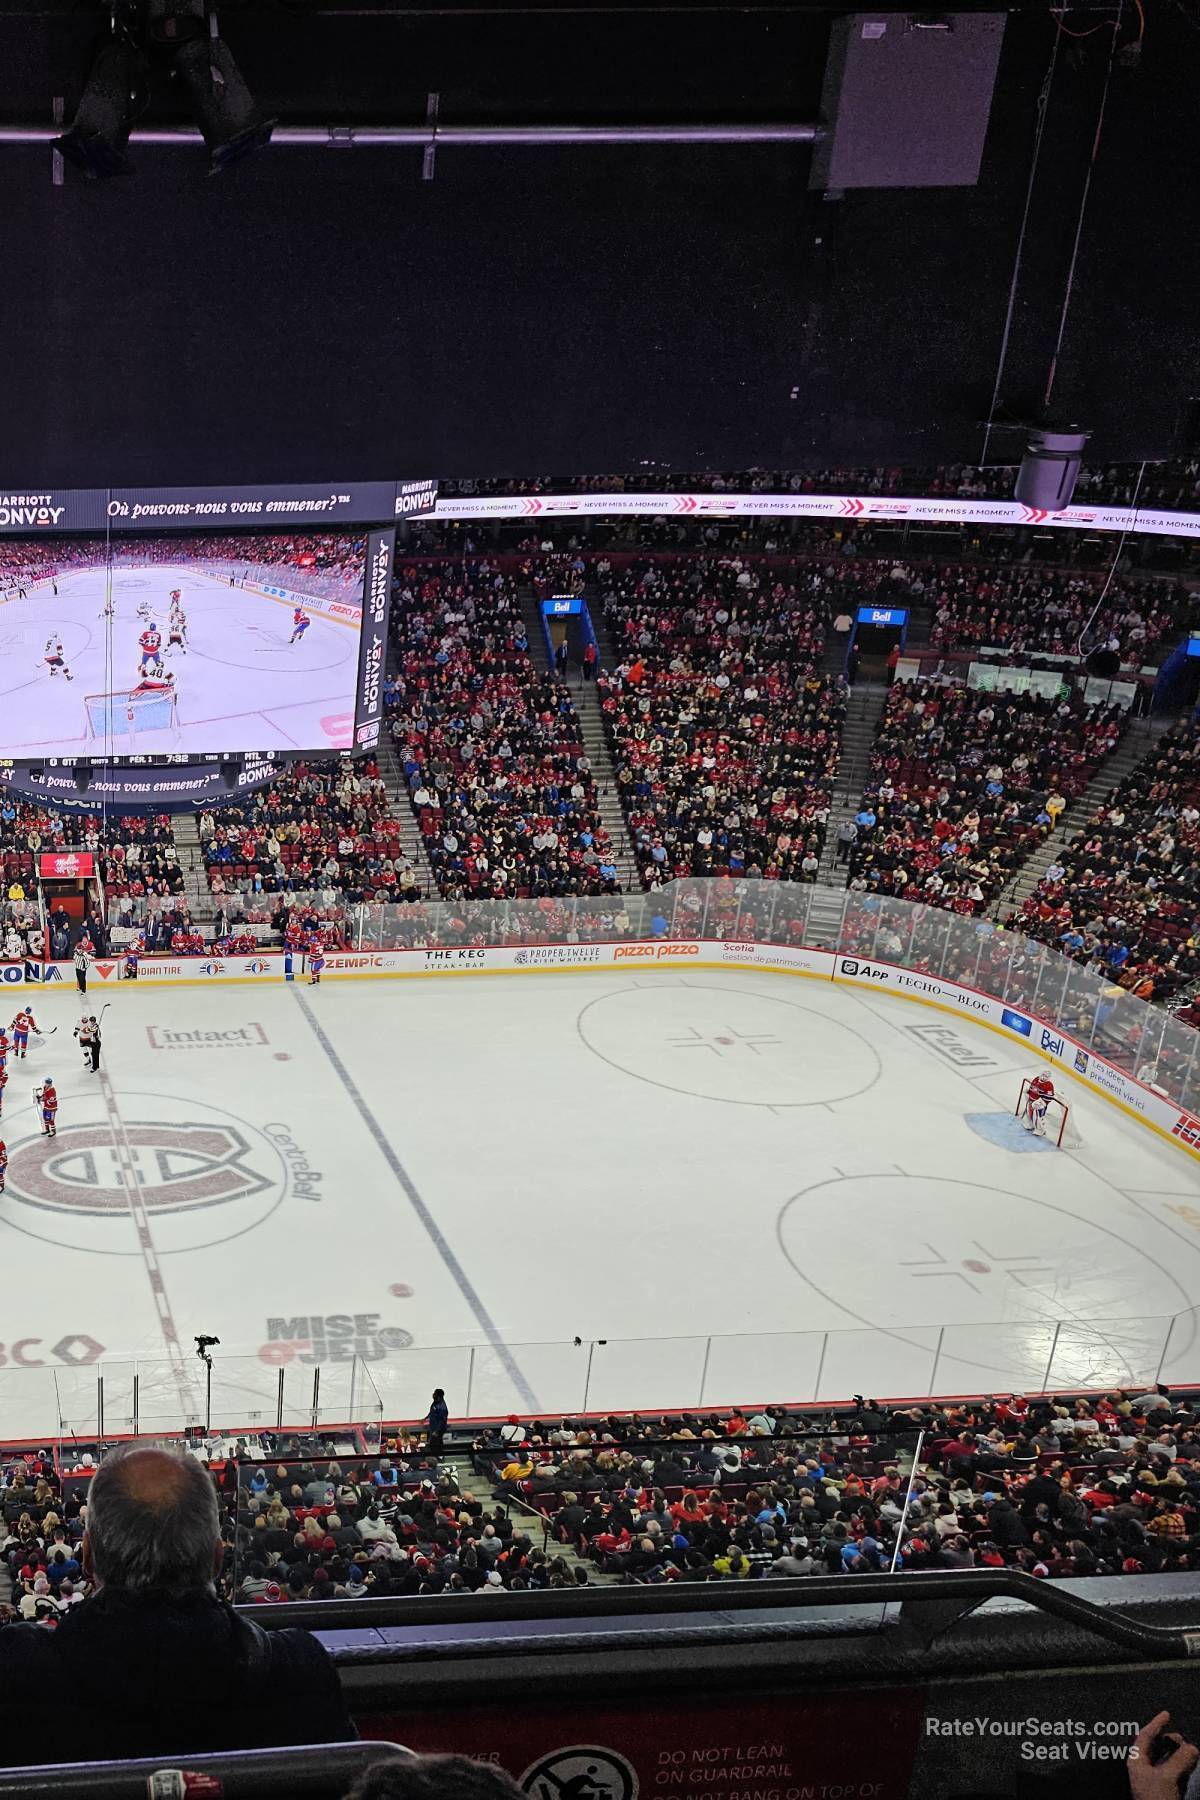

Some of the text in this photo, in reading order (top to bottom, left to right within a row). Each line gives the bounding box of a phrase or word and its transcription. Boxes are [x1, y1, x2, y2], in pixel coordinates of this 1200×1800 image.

[402, 480, 433, 494] MARRIOTT
[107, 500, 129, 516] Où
[131, 501, 227, 518] pouvons-nous
[230, 502, 262, 513] vous
[394, 490, 438, 514] BONVOY
[370, 554, 378, 614] MARRIOTT
[374, 539, 389, 622] BONVOY
[554, 602, 570, 612] Bell
[872, 610, 892, 622] Bell
[364, 648, 372, 706] MARRIOTT
[368, 634, 383, 714] BONVOY
[62, 758, 78, 766] OTT
[244, 752, 262, 761] MTL
[124, 782, 151, 792] vous
[425, 950, 486, 960] THE KEG
[614, 945, 699, 960] pizza pizza
[723, 943, 755, 953] Scotia
[722, 953, 754, 961] Gestion
[163, 966, 182, 975] TIRE
[859, 966, 889, 981] App
[162, 1028, 254, 1043] intact
[1040, 1028, 1064, 1057] Bell
[1123, 1092, 1134, 1104] vie
[1135, 1098, 1145, 1111] ici
[1172, 1114, 1200, 1150] IG
[266, 1314, 380, 1341] MISE
[658, 1745, 784, 1764] DO NOT LEAN
[655, 1764, 792, 1784] ON GUARDRAIL
[820, 1785, 855, 1799] TOP
